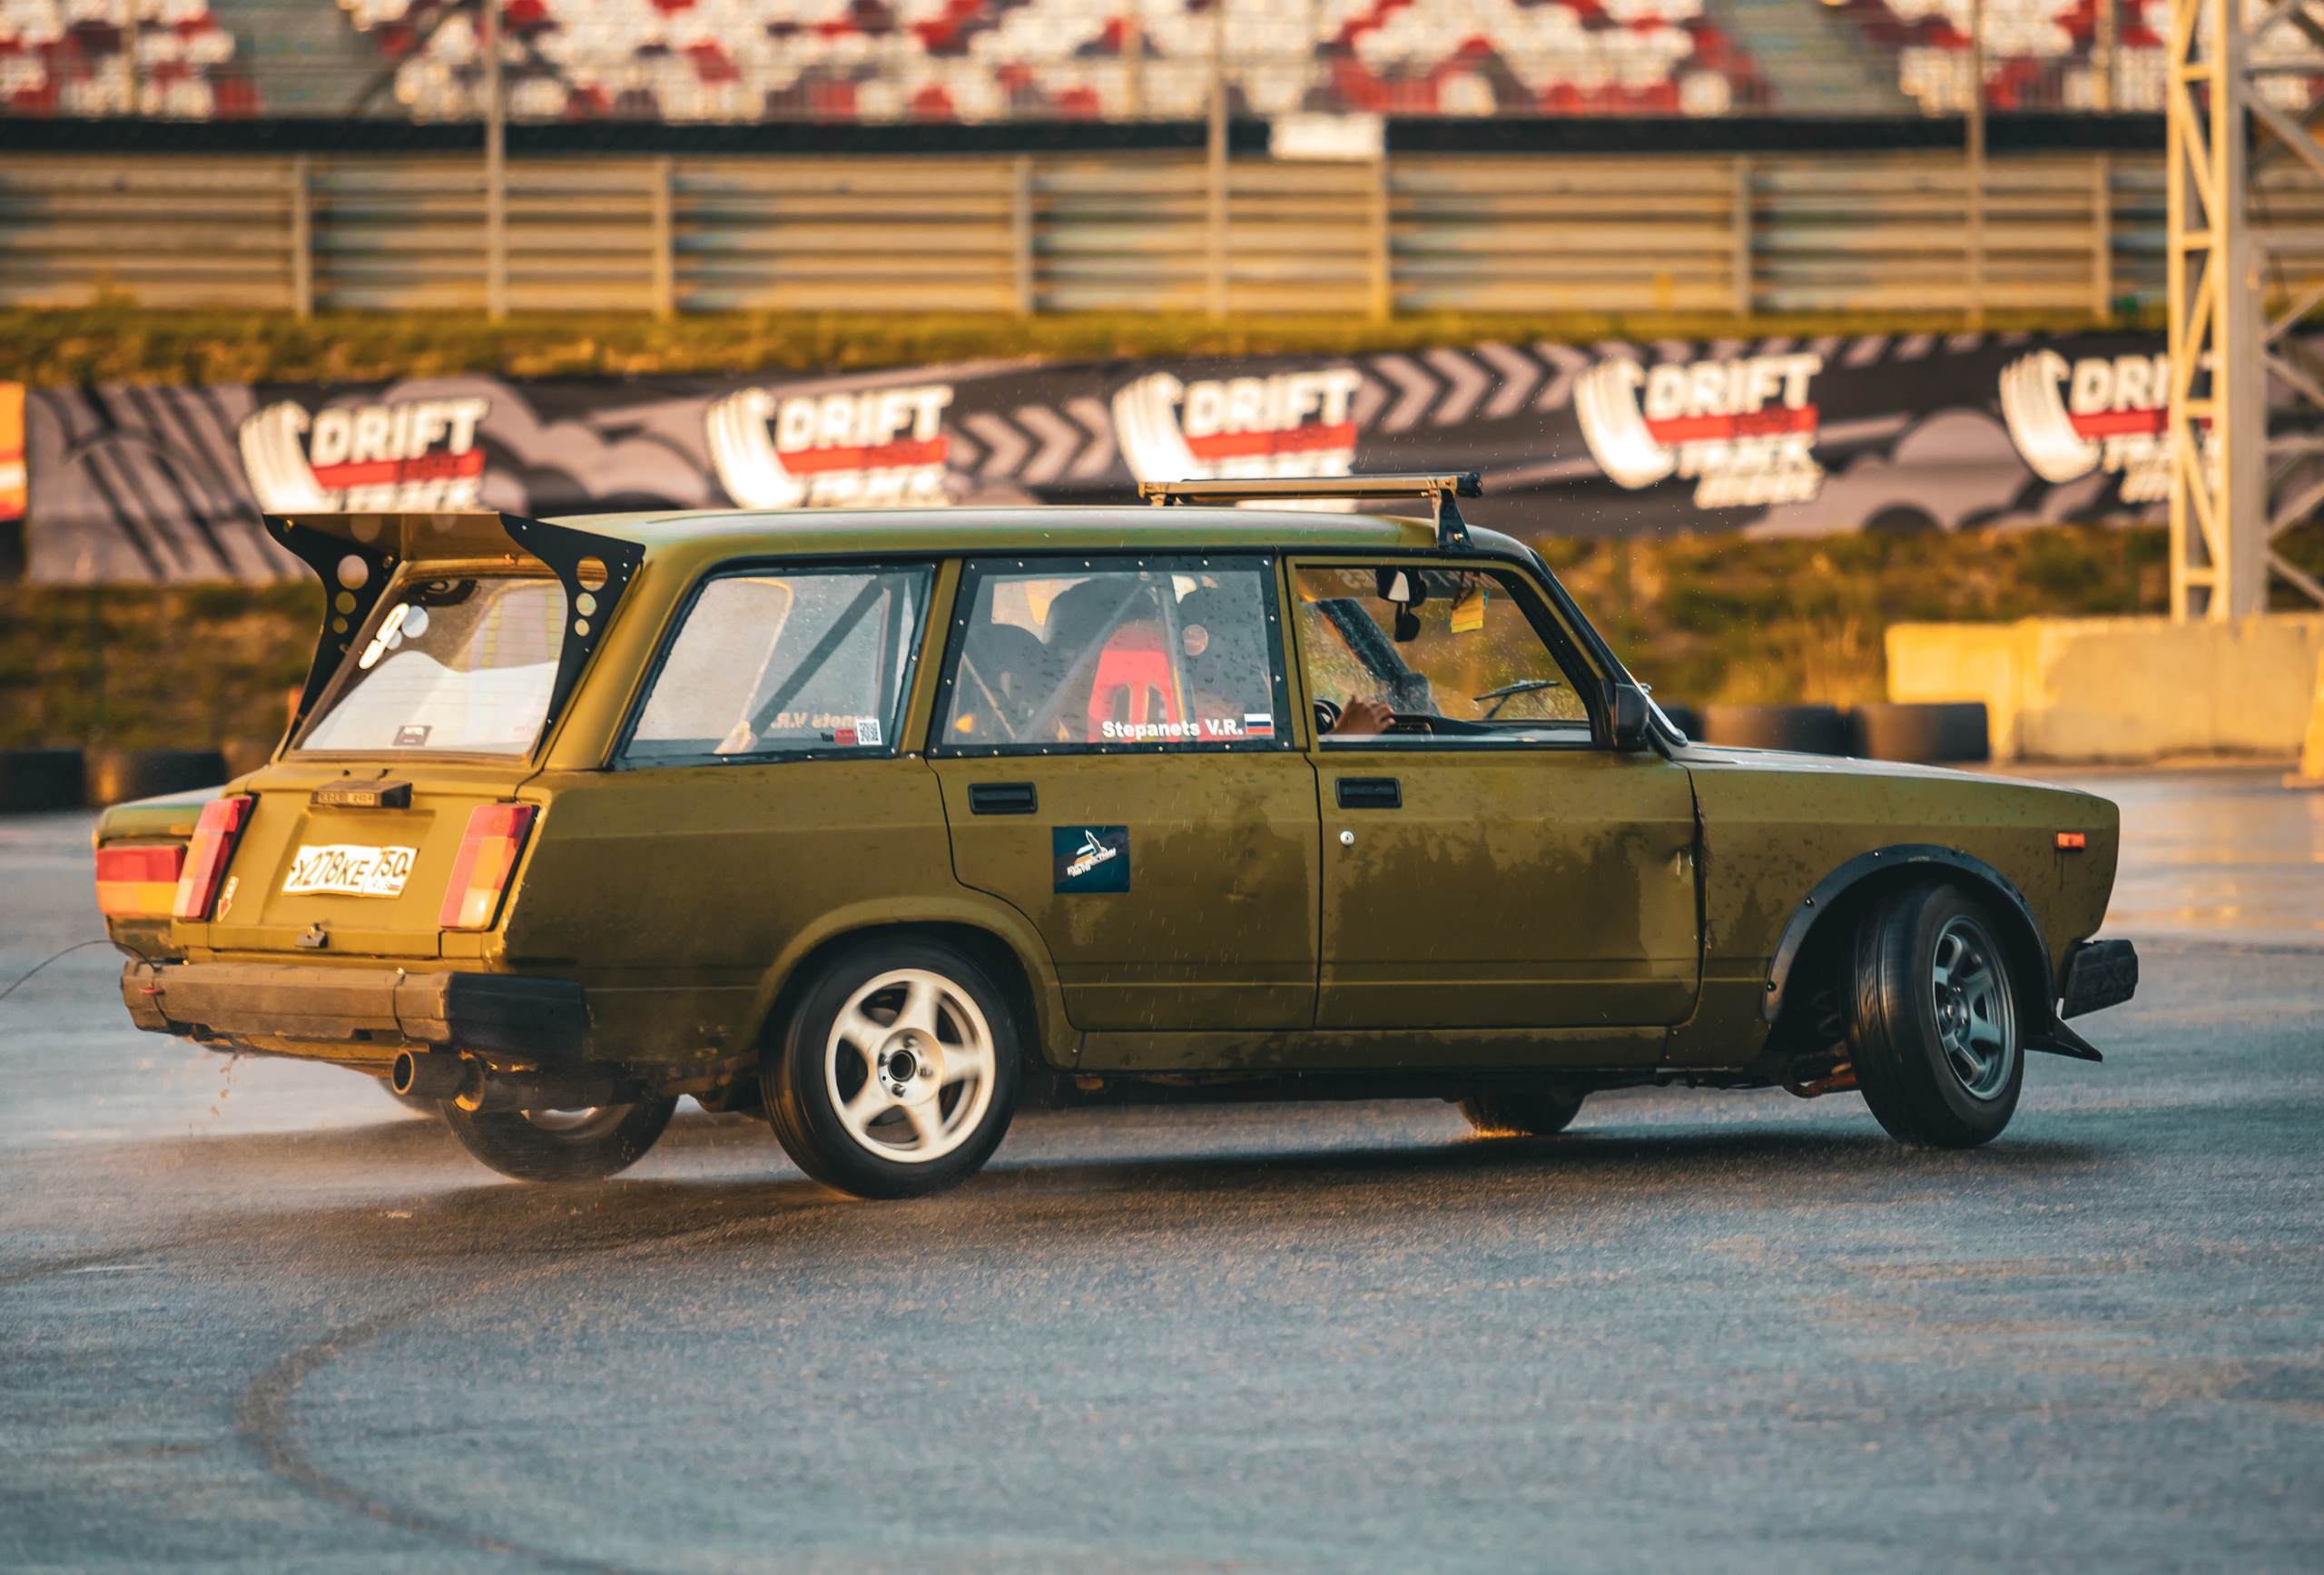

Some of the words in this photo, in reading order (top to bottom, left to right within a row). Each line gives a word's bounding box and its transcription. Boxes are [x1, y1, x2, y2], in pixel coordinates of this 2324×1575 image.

[1184, 369, 1361, 438] DRIFT
[1645, 353, 1823, 419] DRIFT
[2069, 354, 2173, 415] DRI
[311, 399, 489, 467] DRIFT
[776, 386, 954, 452] DRIFT
[1101, 721, 1200, 741] Stepanets
[1205, 718, 1243, 736] V.R.
[371, 850, 410, 879] 750
